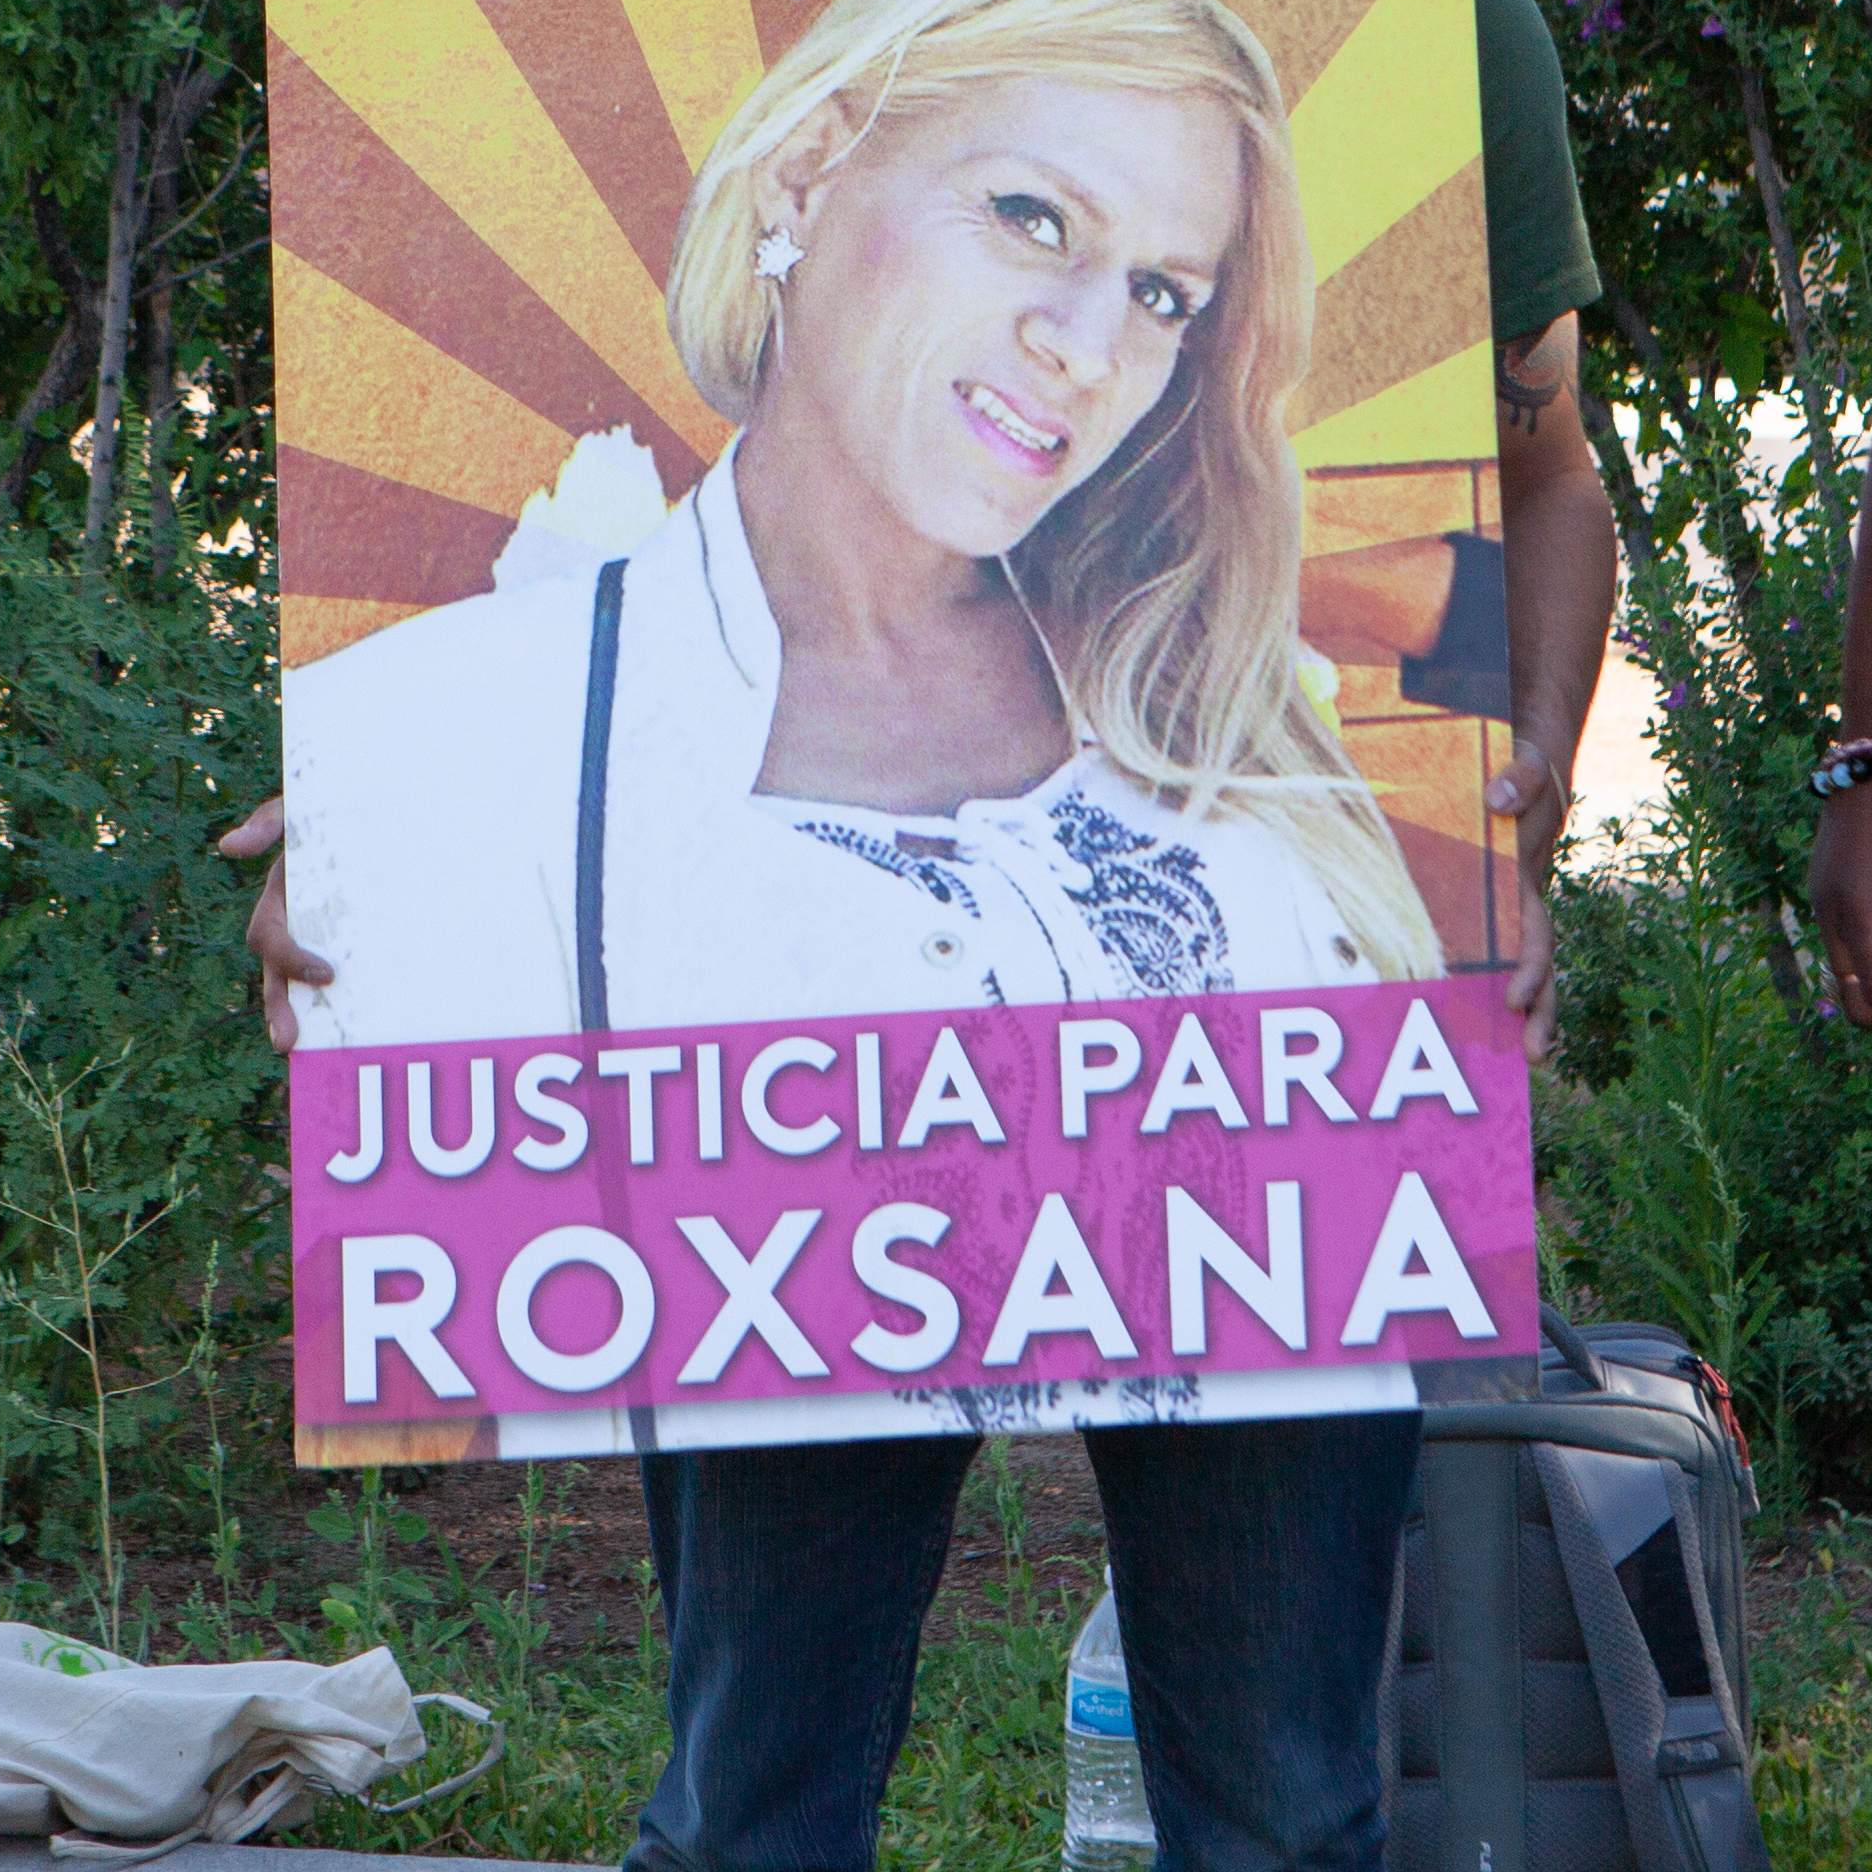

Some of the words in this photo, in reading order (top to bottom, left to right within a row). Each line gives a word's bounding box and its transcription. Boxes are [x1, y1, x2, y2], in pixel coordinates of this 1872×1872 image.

[325, 1026, 1006, 1184] JUSTICIA
[1058, 997, 1480, 1140] PARA
[341, 1171, 1499, 1404] ROXSANA
